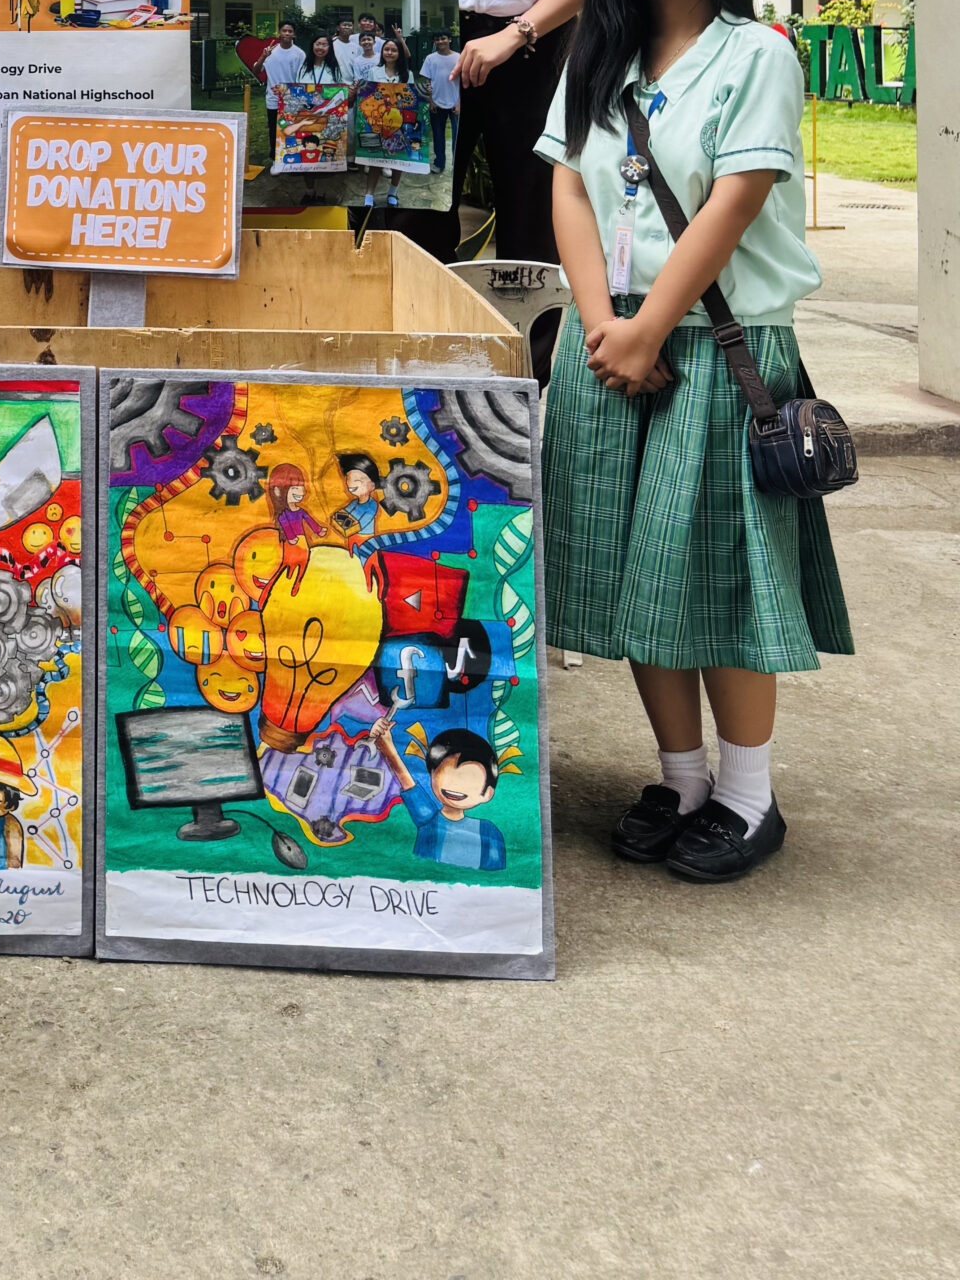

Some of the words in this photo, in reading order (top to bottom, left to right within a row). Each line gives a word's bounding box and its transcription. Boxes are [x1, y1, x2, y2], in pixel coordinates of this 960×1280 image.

[28, 63, 62, 74] Drive
[23, 89, 77, 100] National
[81, 89, 154, 102] Highschool
[26, 138, 111, 173] DROP
[122, 141, 207, 175] YOUR
[26, 175, 207, 214] DONATIONS
[70, 213, 171, 249] HERE!
[175, 874, 355, 909] TECHNOLOGY
[370, 885, 439, 916] DRIVE
[0, 910, 32, 925] 20
